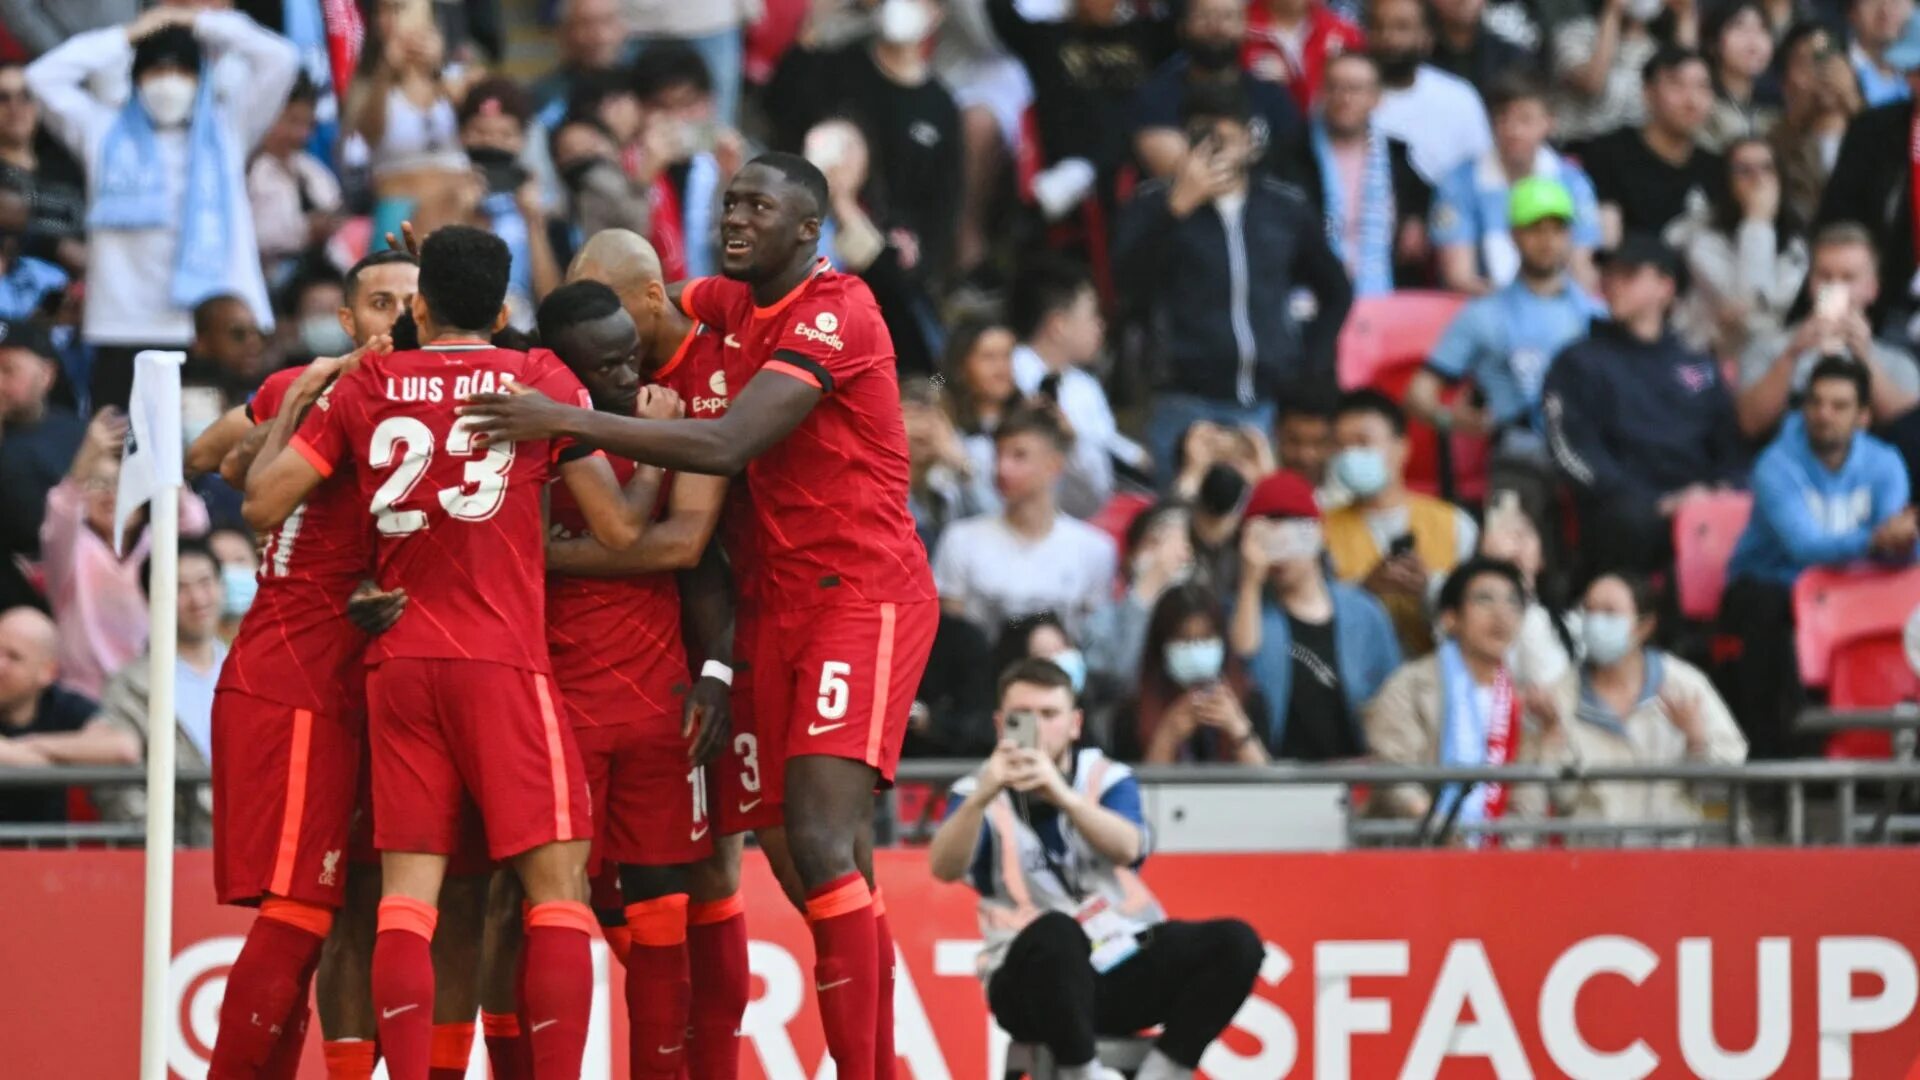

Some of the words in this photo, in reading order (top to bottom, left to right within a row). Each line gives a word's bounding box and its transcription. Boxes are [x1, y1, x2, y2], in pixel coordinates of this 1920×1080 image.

[794, 322, 845, 351] Expedia
[386, 376, 444, 403] LUIS
[453, 369, 515, 401] DÍAZ
[692, 396, 729, 413] Expe
[369, 416, 516, 537] 23
[816, 660, 851, 720] 5
[734, 732, 761, 793] 3
[687, 764, 708, 823] 1
